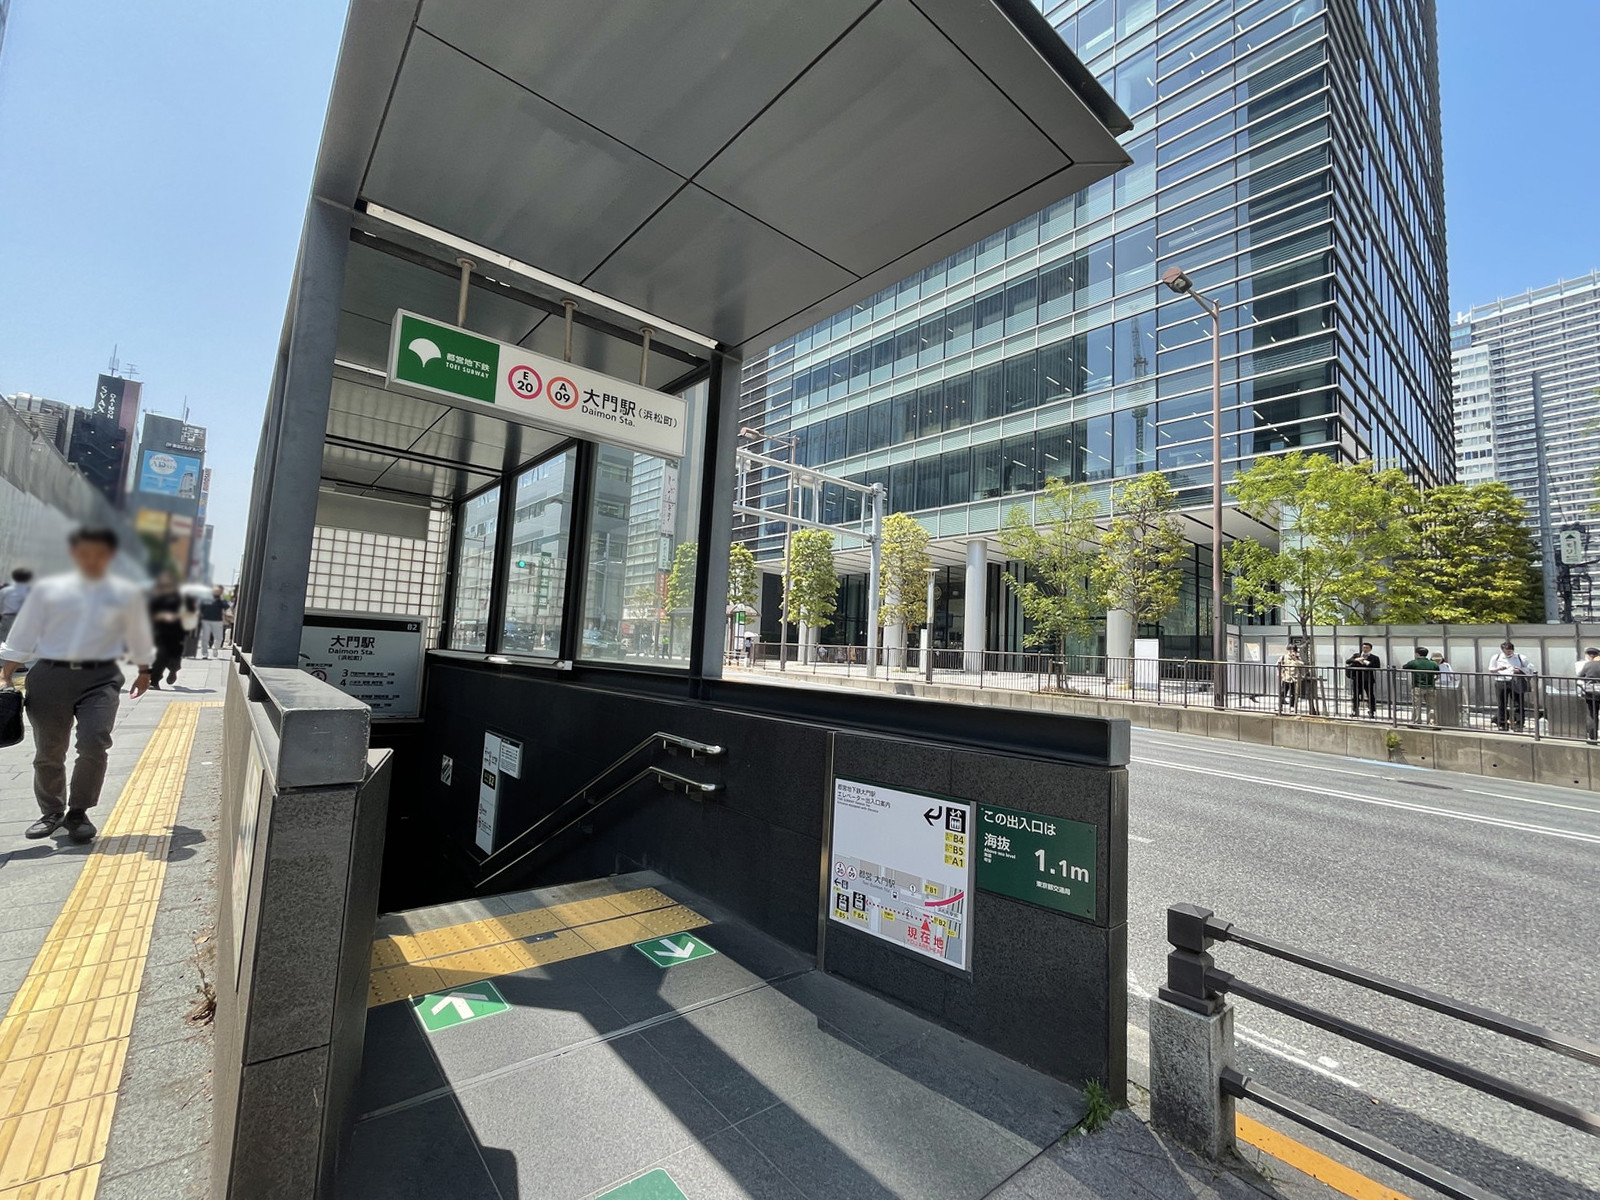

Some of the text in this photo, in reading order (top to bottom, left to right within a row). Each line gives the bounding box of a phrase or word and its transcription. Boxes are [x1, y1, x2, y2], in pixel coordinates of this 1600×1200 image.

[446, 353, 490, 372] 都営地下鉄
[446, 362, 490, 379] TOEI SUBWAY
[523, 371, 529, 381] E
[517, 380, 534, 393] 20
[558, 383, 568, 392] A
[554, 391, 571, 403] 09
[583, 388, 678, 429] 大門駅 (浜松町)
[581, 404, 636, 428] Daimon Sta.
[331, 634, 376, 649] 大門駅
[328, 647, 359, 655] Daimon
[984, 810, 1057, 836] この出入口は
[952, 834, 964, 845] B4
[984, 832, 1011, 852] 海抜
[952, 845, 964, 856] B5
[951, 857, 964, 867] A1
[1034, 849, 1090, 884] 1.1m
[874, 875, 896, 889] 大門駅
[938, 919, 947, 928] B2
[907, 926, 945, 950] 現在地
